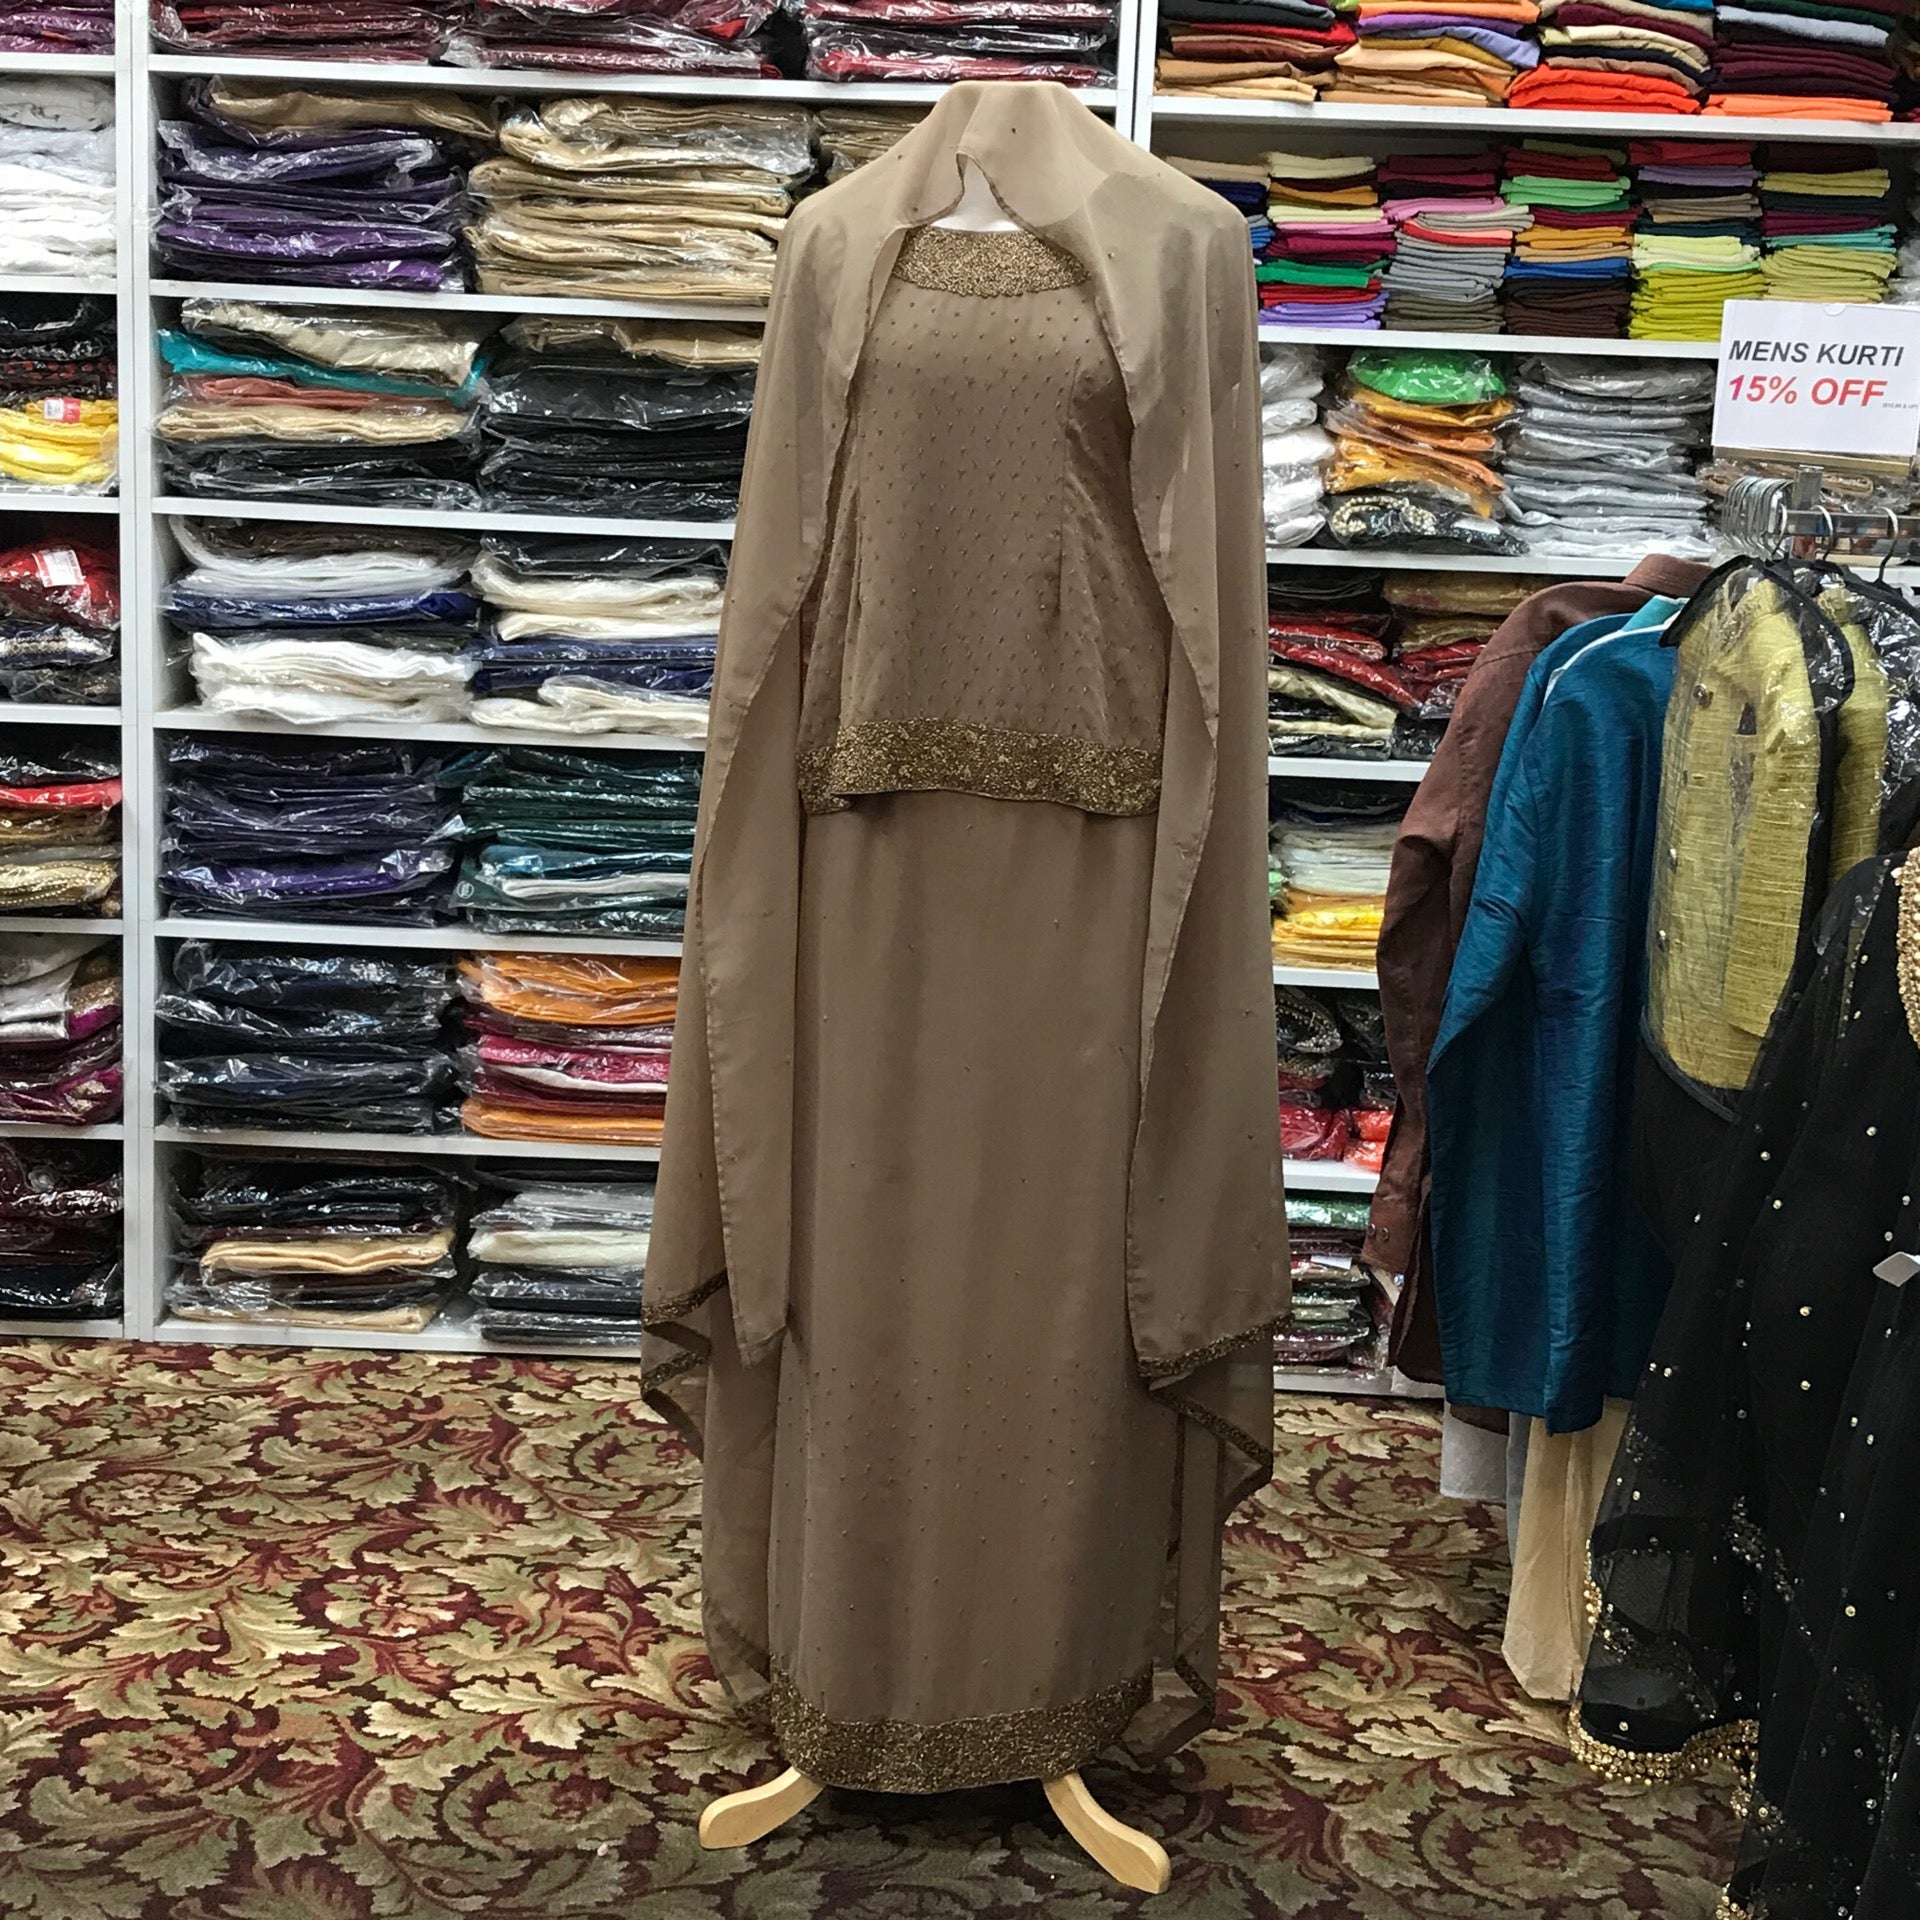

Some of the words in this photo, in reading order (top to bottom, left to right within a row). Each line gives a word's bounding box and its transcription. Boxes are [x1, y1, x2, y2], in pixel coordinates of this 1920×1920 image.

[1728, 340, 1809, 363] MENS
[1816, 343, 1904, 367] KURTI
[1729, 374, 1798, 405] 15%
[1811, 377, 1888, 407] OFF
